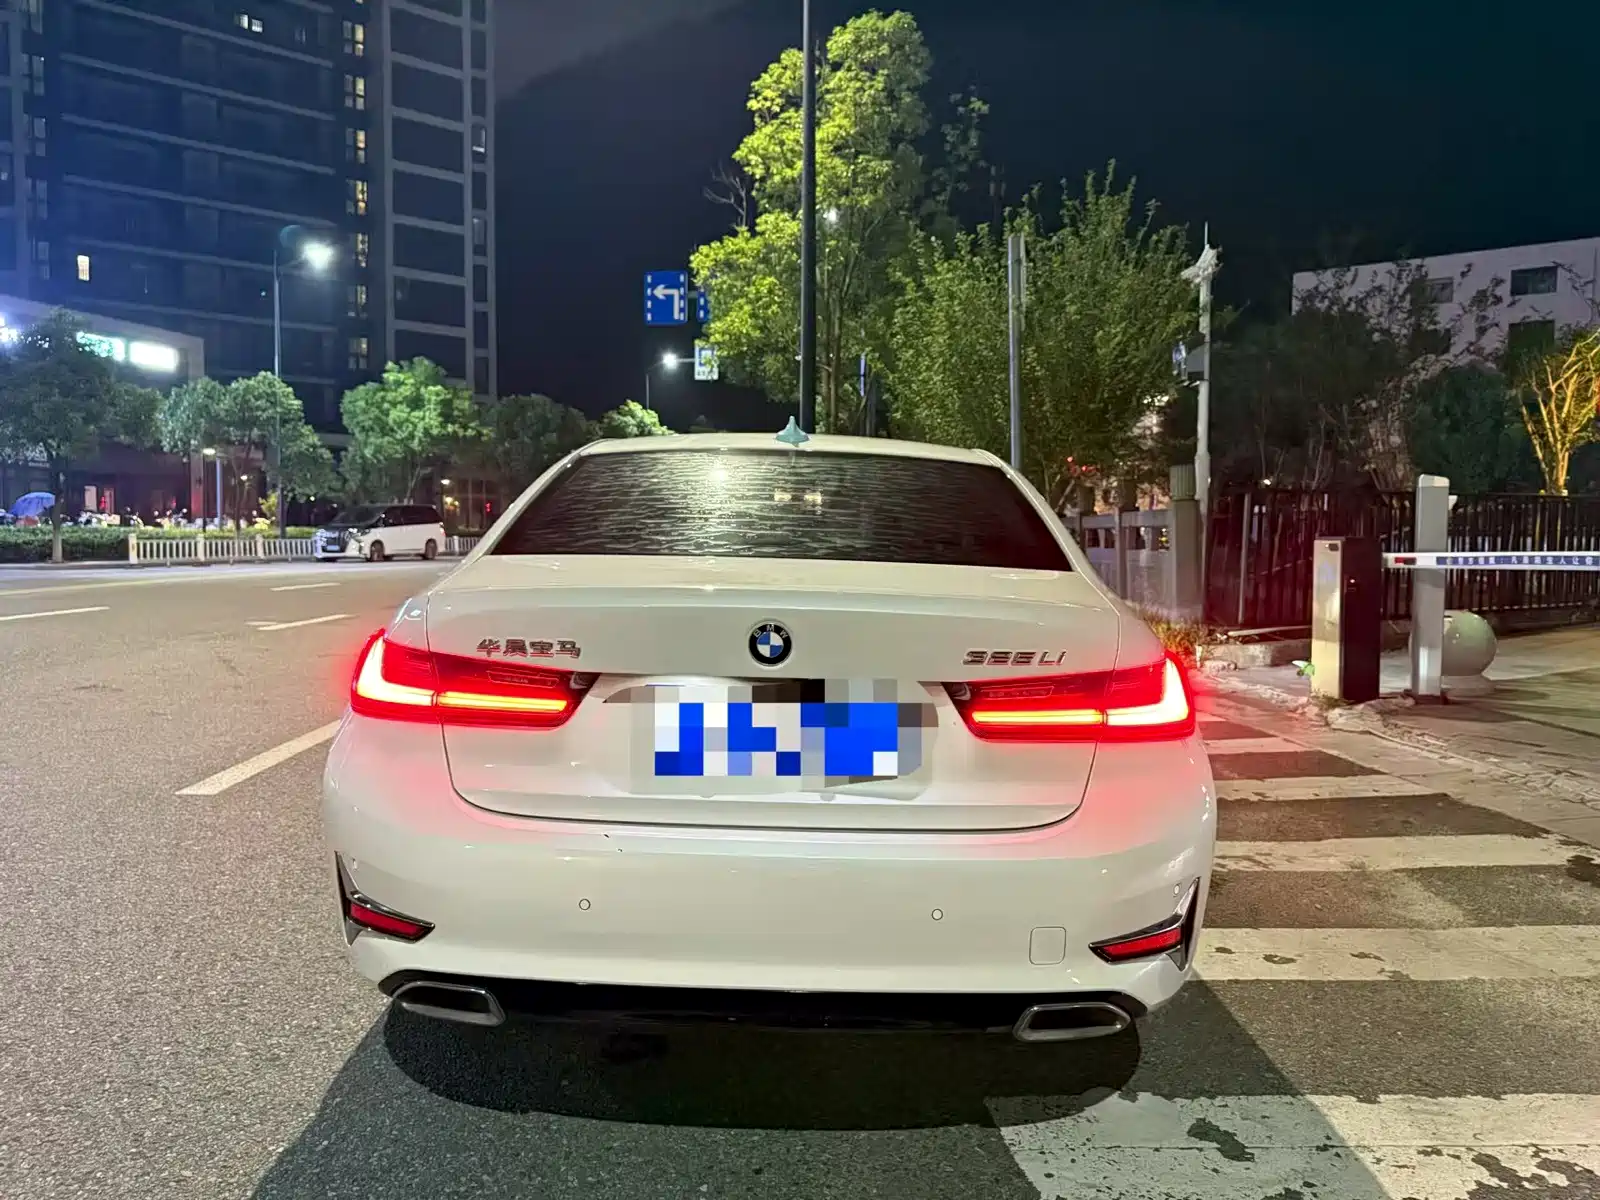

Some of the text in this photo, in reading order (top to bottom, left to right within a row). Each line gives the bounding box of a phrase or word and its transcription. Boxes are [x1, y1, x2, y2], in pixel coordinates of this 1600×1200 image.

[753, 624, 789, 639] BMW
[476, 637, 582, 659] 华晨宝马
